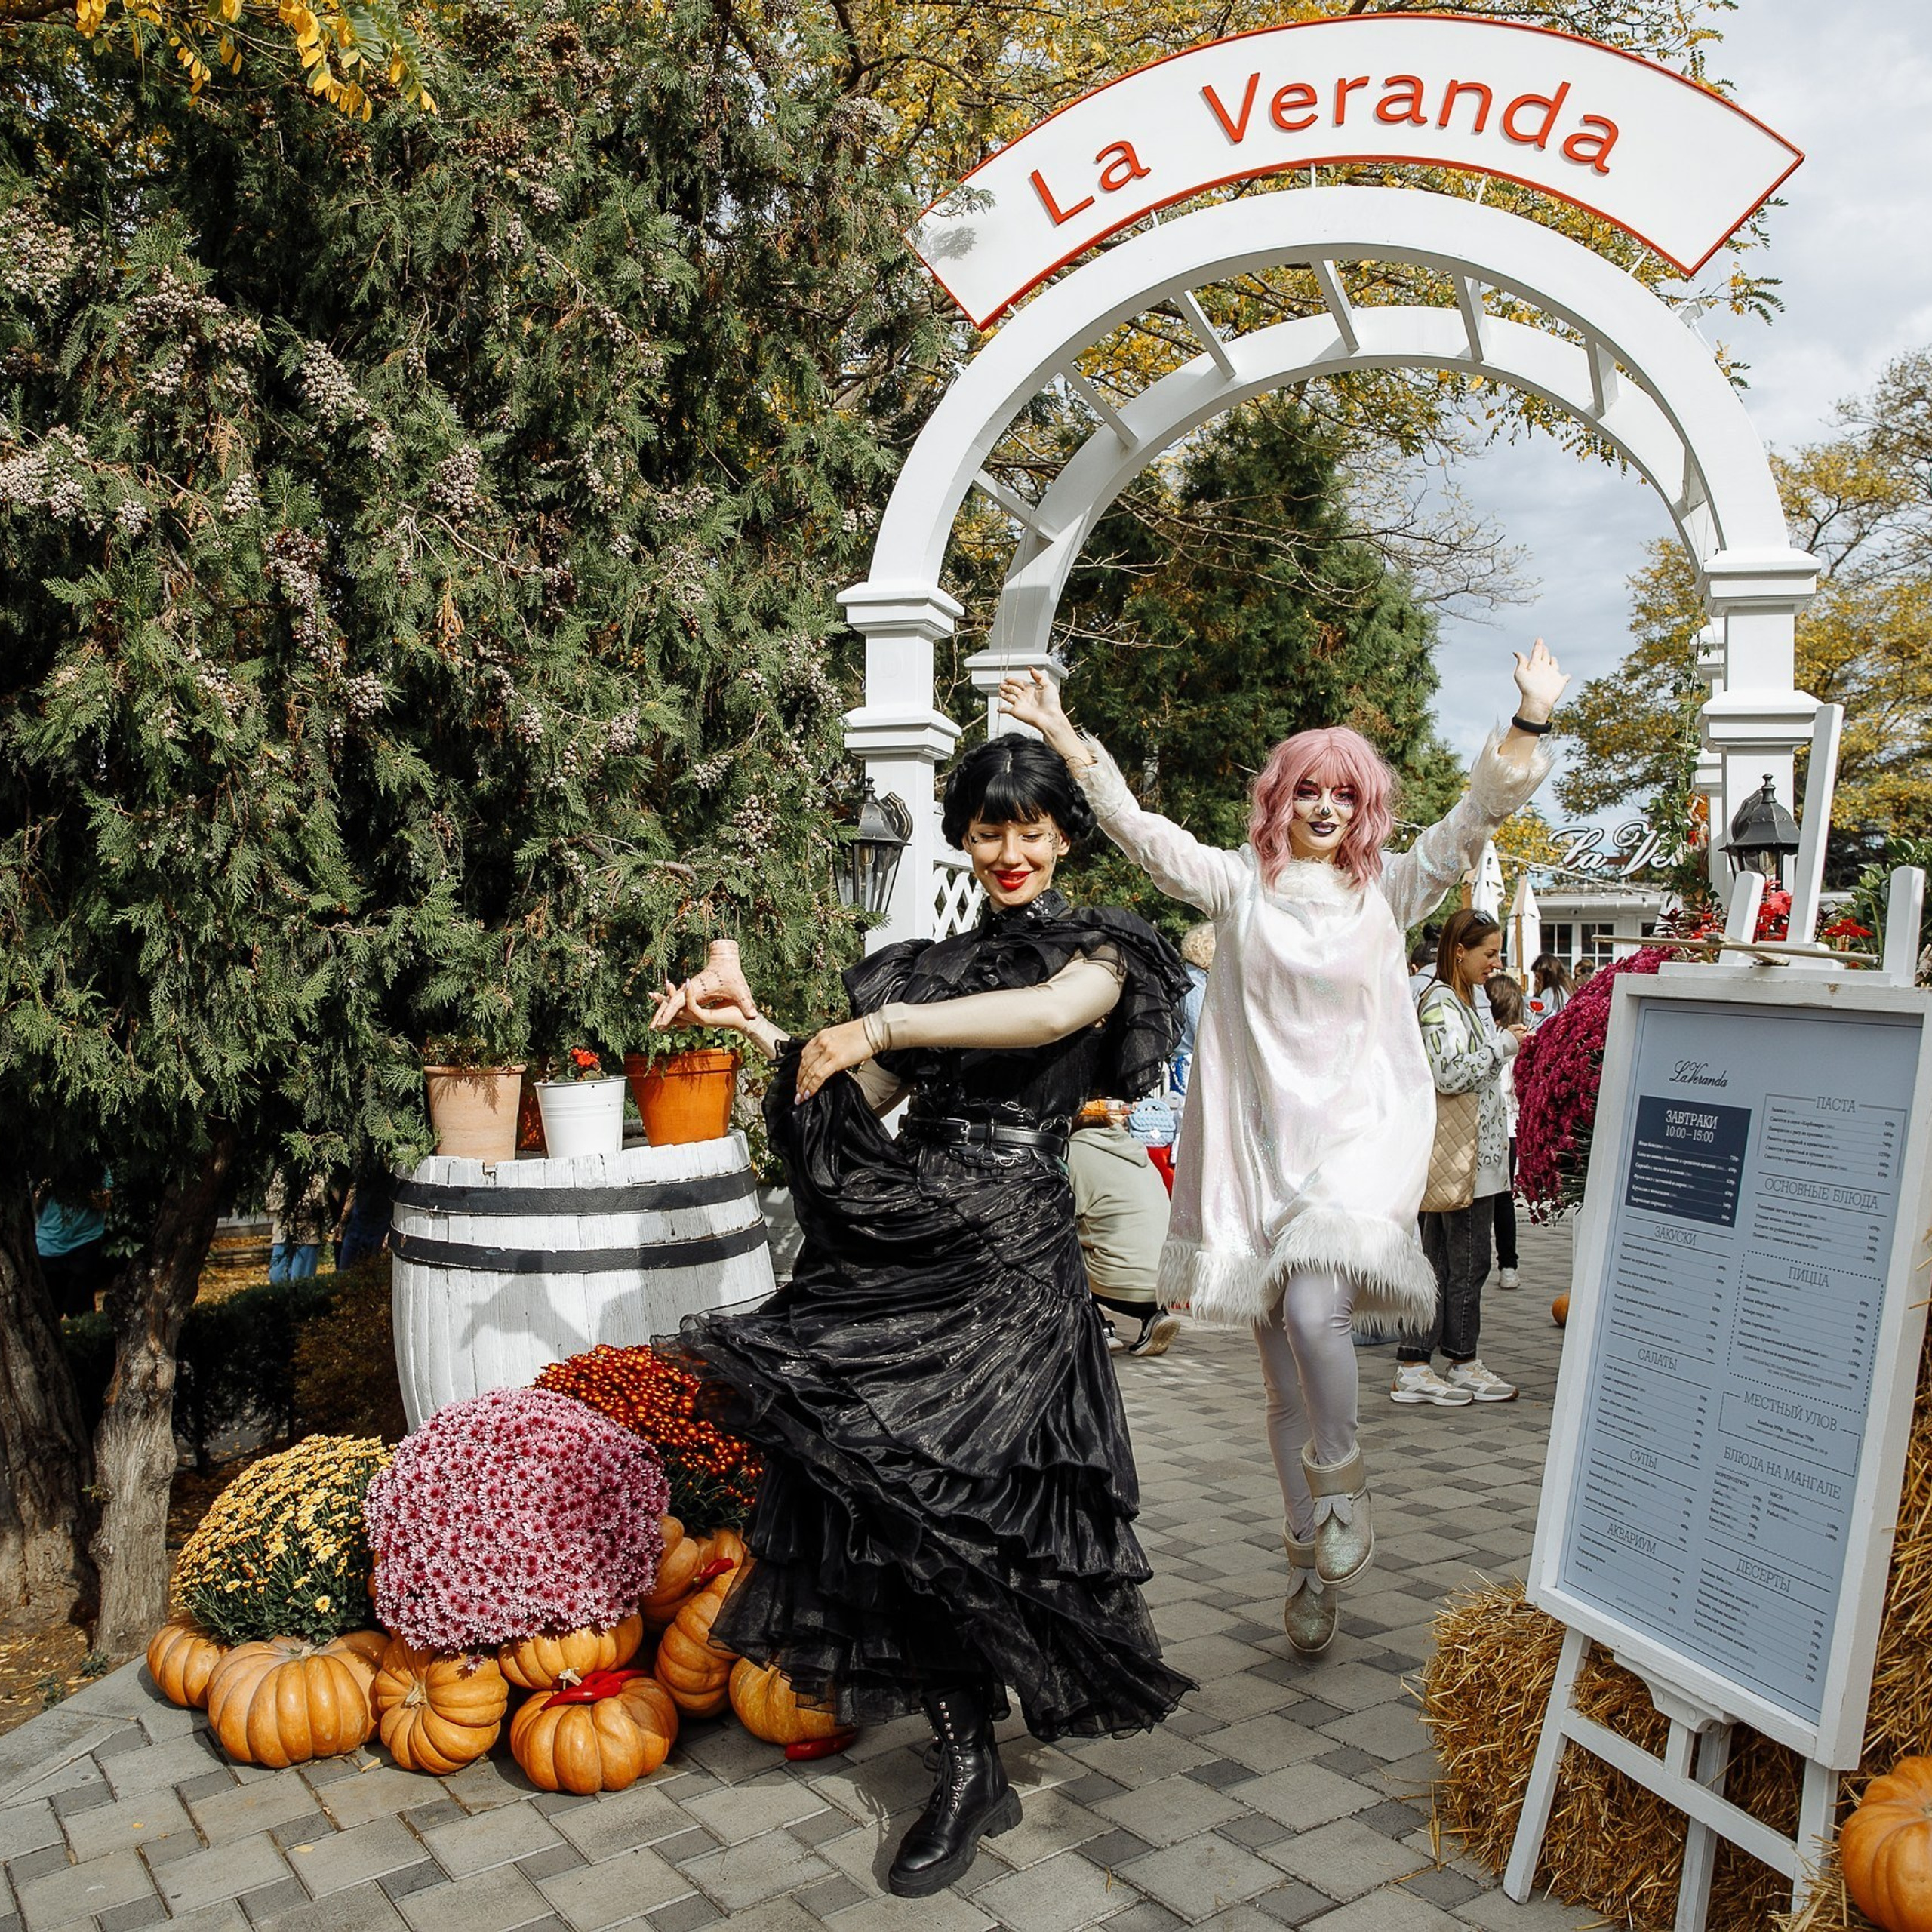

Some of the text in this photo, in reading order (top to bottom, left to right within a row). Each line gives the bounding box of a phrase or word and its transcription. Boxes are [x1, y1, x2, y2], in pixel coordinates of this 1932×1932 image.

[1030, 72, 1620, 225] La Veranda
[1816, 1097, 1856, 1113] ПАСТА
[1666, 1109, 1718, 1130] ЗАВТРАКИ
[1764, 1177, 1878, 1209] ОСНОВНЫЕ БЛЮДА
[1654, 1226, 1697, 1246] ЗАКУСКИ
[1788, 1266, 1829, 1287] ПИЦЦА
[1638, 1348, 1678, 1371] САЛАТЫ
[1743, 1391, 1838, 1431] МЕСТНЫЙ УЛОВ
[1629, 1448, 1658, 1469] СУПЫ
[1724, 1446, 1842, 1500] БЛЮДА НА МАНГАЛЕ
[1607, 1522, 1657, 1555] АКВАРИУМ
[1735, 1558, 1791, 1592] ДЕСЕРТЫ
